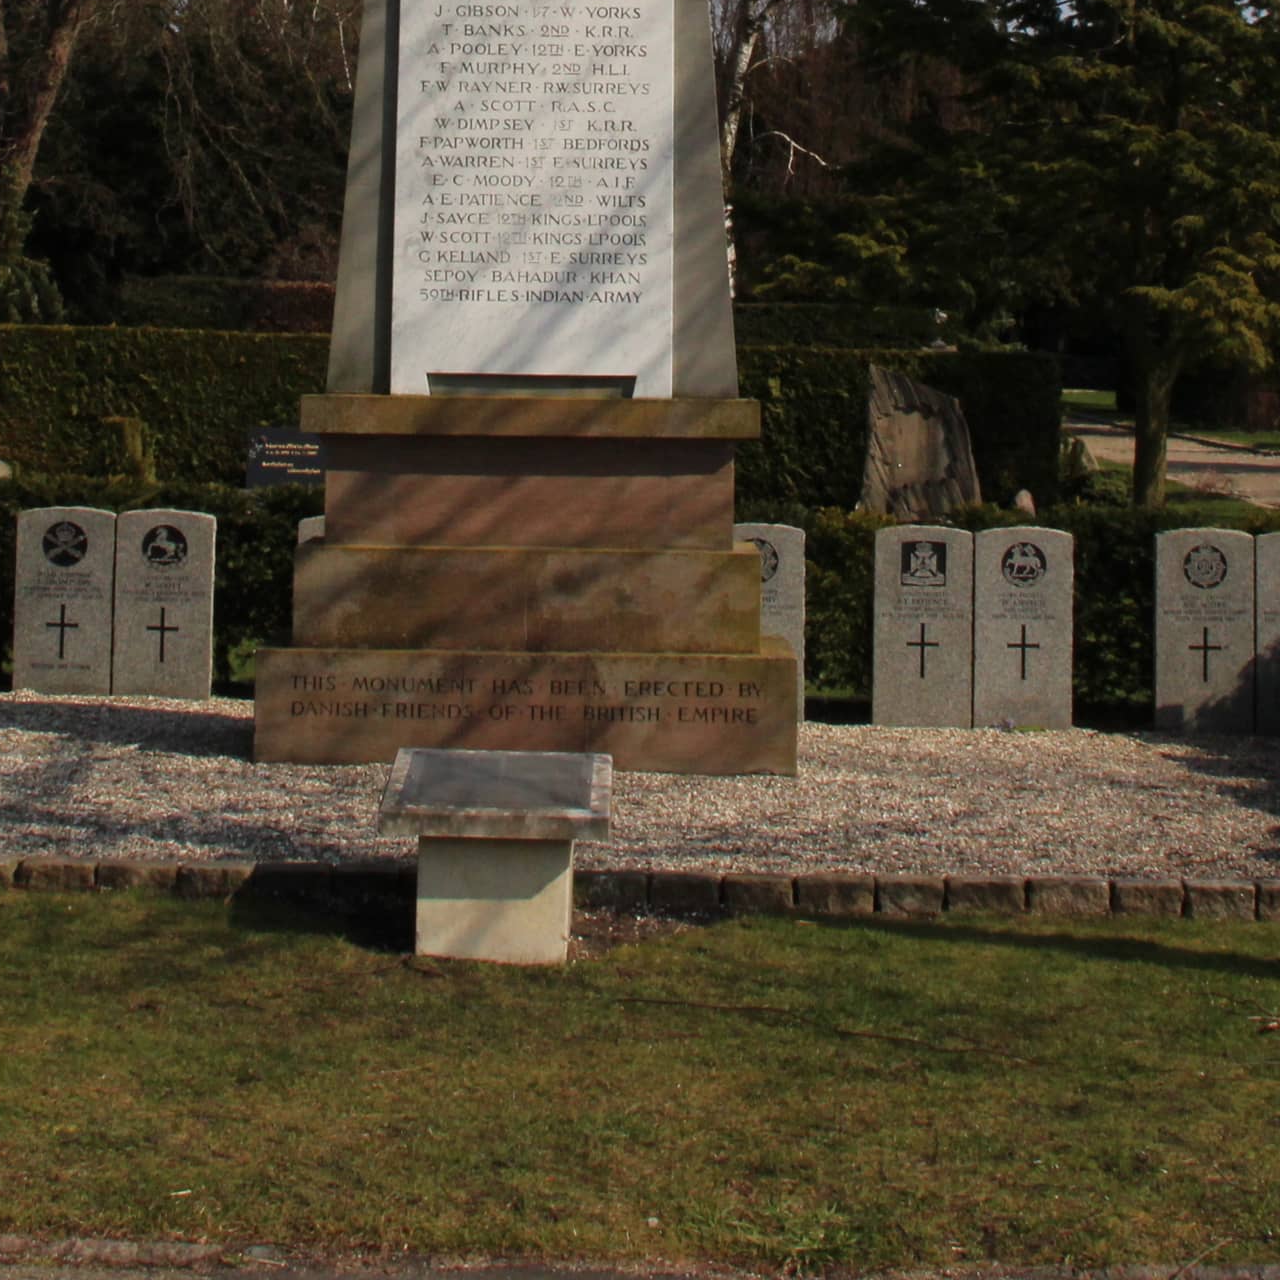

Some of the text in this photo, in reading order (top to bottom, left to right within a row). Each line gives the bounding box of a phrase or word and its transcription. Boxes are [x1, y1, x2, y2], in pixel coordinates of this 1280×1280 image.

[435, 5, 442, 17] J
[456, 5, 519, 17] GIBSON
[559, 6, 576, 17] W
[588, 6, 641, 19] YORKS
[441, 24, 453, 35] T
[464, 24, 525, 36] BANKS
[426, 44, 441, 54] A
[451, 44, 522, 56] POOLEY
[574, 44, 584, 56] E
[592, 44, 648, 57] YORKS
[460, 62, 540, 75] MURPHY
[435, 80, 449, 91] W
[459, 81, 532, 93] RAYNER
[454, 101, 466, 112] A
[480, 100, 536, 112] SCOTT
[434, 118, 451, 129] W
[457, 119, 534, 130] DIMPSEY
[433, 137, 523, 149] PAPWORTH
[563, 138, 649, 151] BEDFORDS
[422, 155, 435, 167] A
[440, 155, 514, 168] WARREN
[573, 157, 648, 170] SURREYS
[432, 174, 445, 186] E
[473, 175, 535, 187] MOODY
[422, 193, 435, 205] A
[440, 193, 453, 206] E
[460, 193, 543, 207] PATIENCE
[596, 195, 646, 208] WILTS
[437, 213, 490, 225] SAYCE
[532, 214, 582, 226] KINGS
[420, 232, 435, 243] W
[440, 232, 491, 244] SCOTT
[533, 233, 582, 245] KINGS
[437, 251, 511, 264] KELLAND
[570, 252, 648, 265] SURREYS
[424, 270, 641, 284] SEPOY BAHADUR KHAN
[459, 289, 519, 302] RIFLES
[526, 289, 583, 303] INDIAN
[589, 291, 643, 304] ARMY
[291, 675, 763, 698] THIS MONUMENT HAS BEEN ERECTED BY
[290, 701, 758, 724] DANISH FRIENDS OF THE BRITISH EMPIRE
